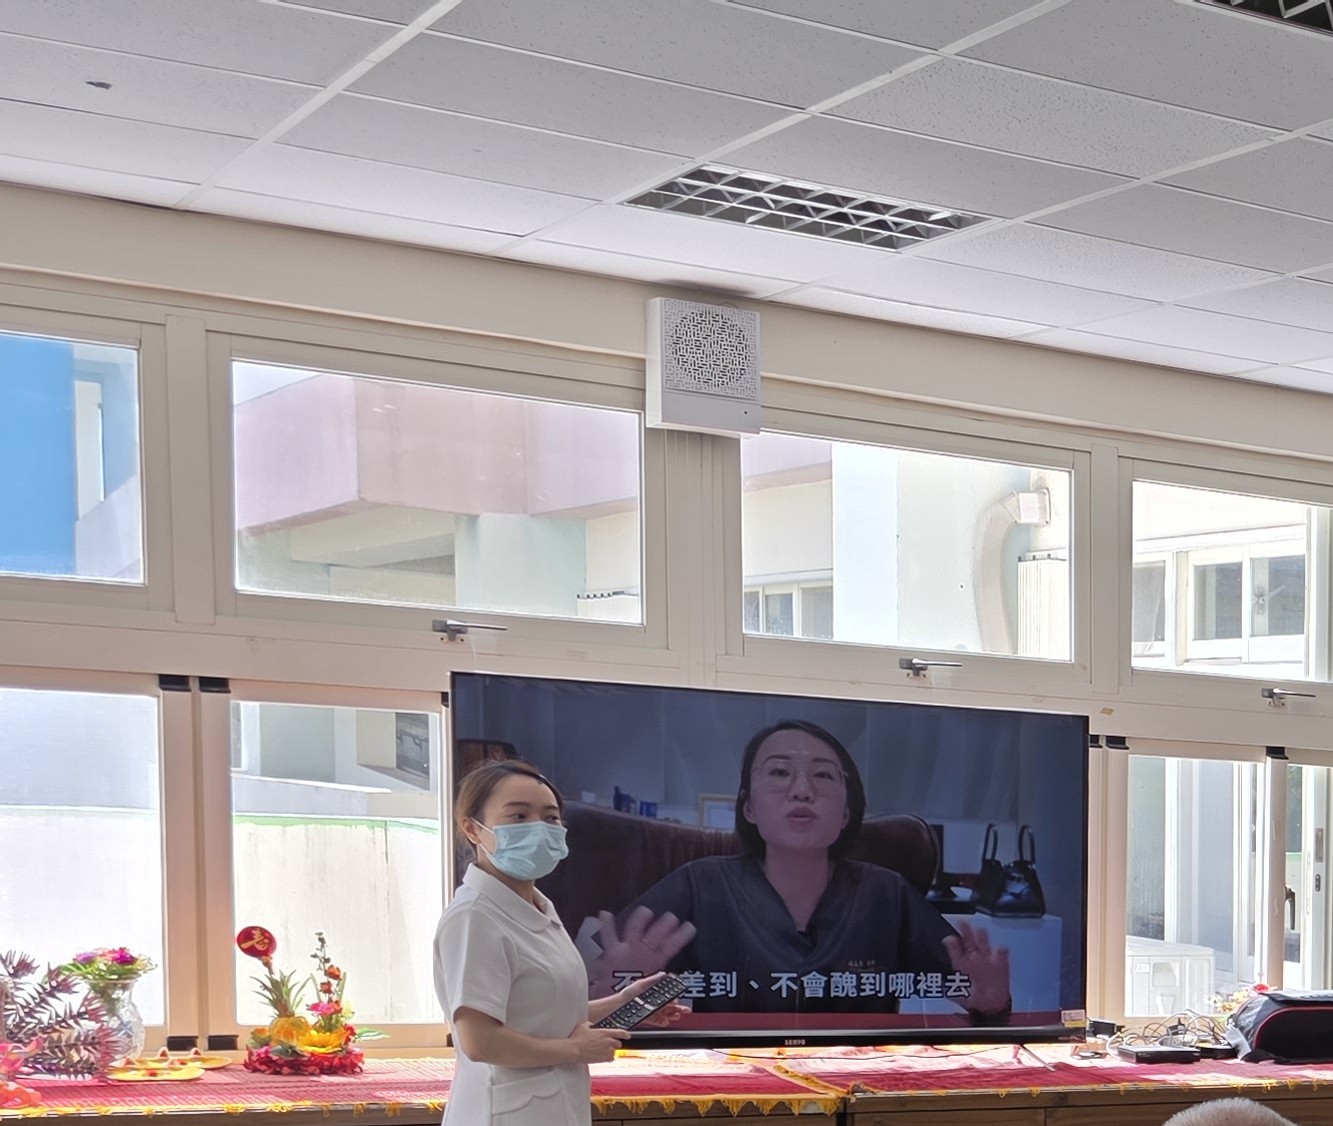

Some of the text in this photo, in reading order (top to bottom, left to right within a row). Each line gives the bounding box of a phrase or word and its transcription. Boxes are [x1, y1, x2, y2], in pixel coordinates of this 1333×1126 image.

[613, 970, 972, 1000] 不差到、不會醜到哪裡去
